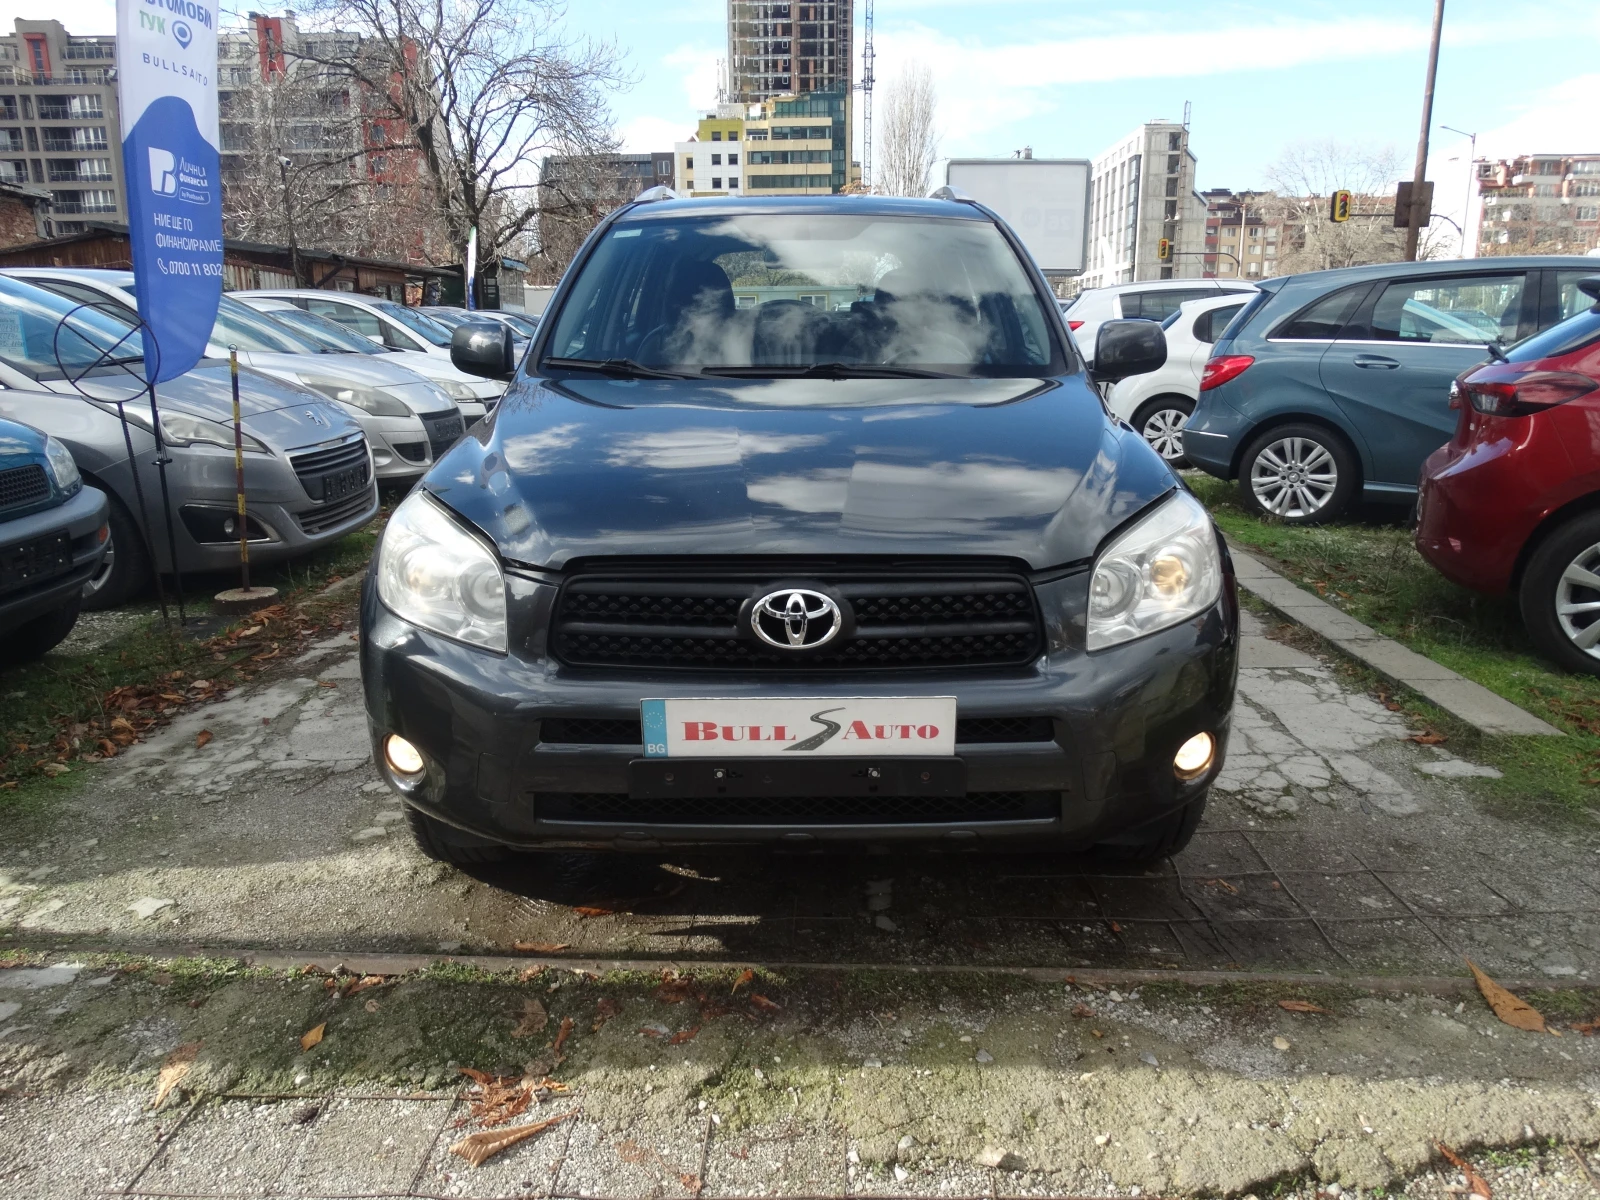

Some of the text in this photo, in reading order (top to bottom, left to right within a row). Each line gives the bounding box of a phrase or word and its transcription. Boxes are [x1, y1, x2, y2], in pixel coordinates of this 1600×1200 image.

[139, 9, 166, 36] ТУК
[145, 0, 212, 30] ОМОБИ
[153, 212, 193, 232] НИЕ ЩЕ ГО
[155, 232, 223, 252] ФИНАНСИРАМЕ
[169, 260, 223, 276] 0700 11 802
[647, 743, 666, 754] BG
